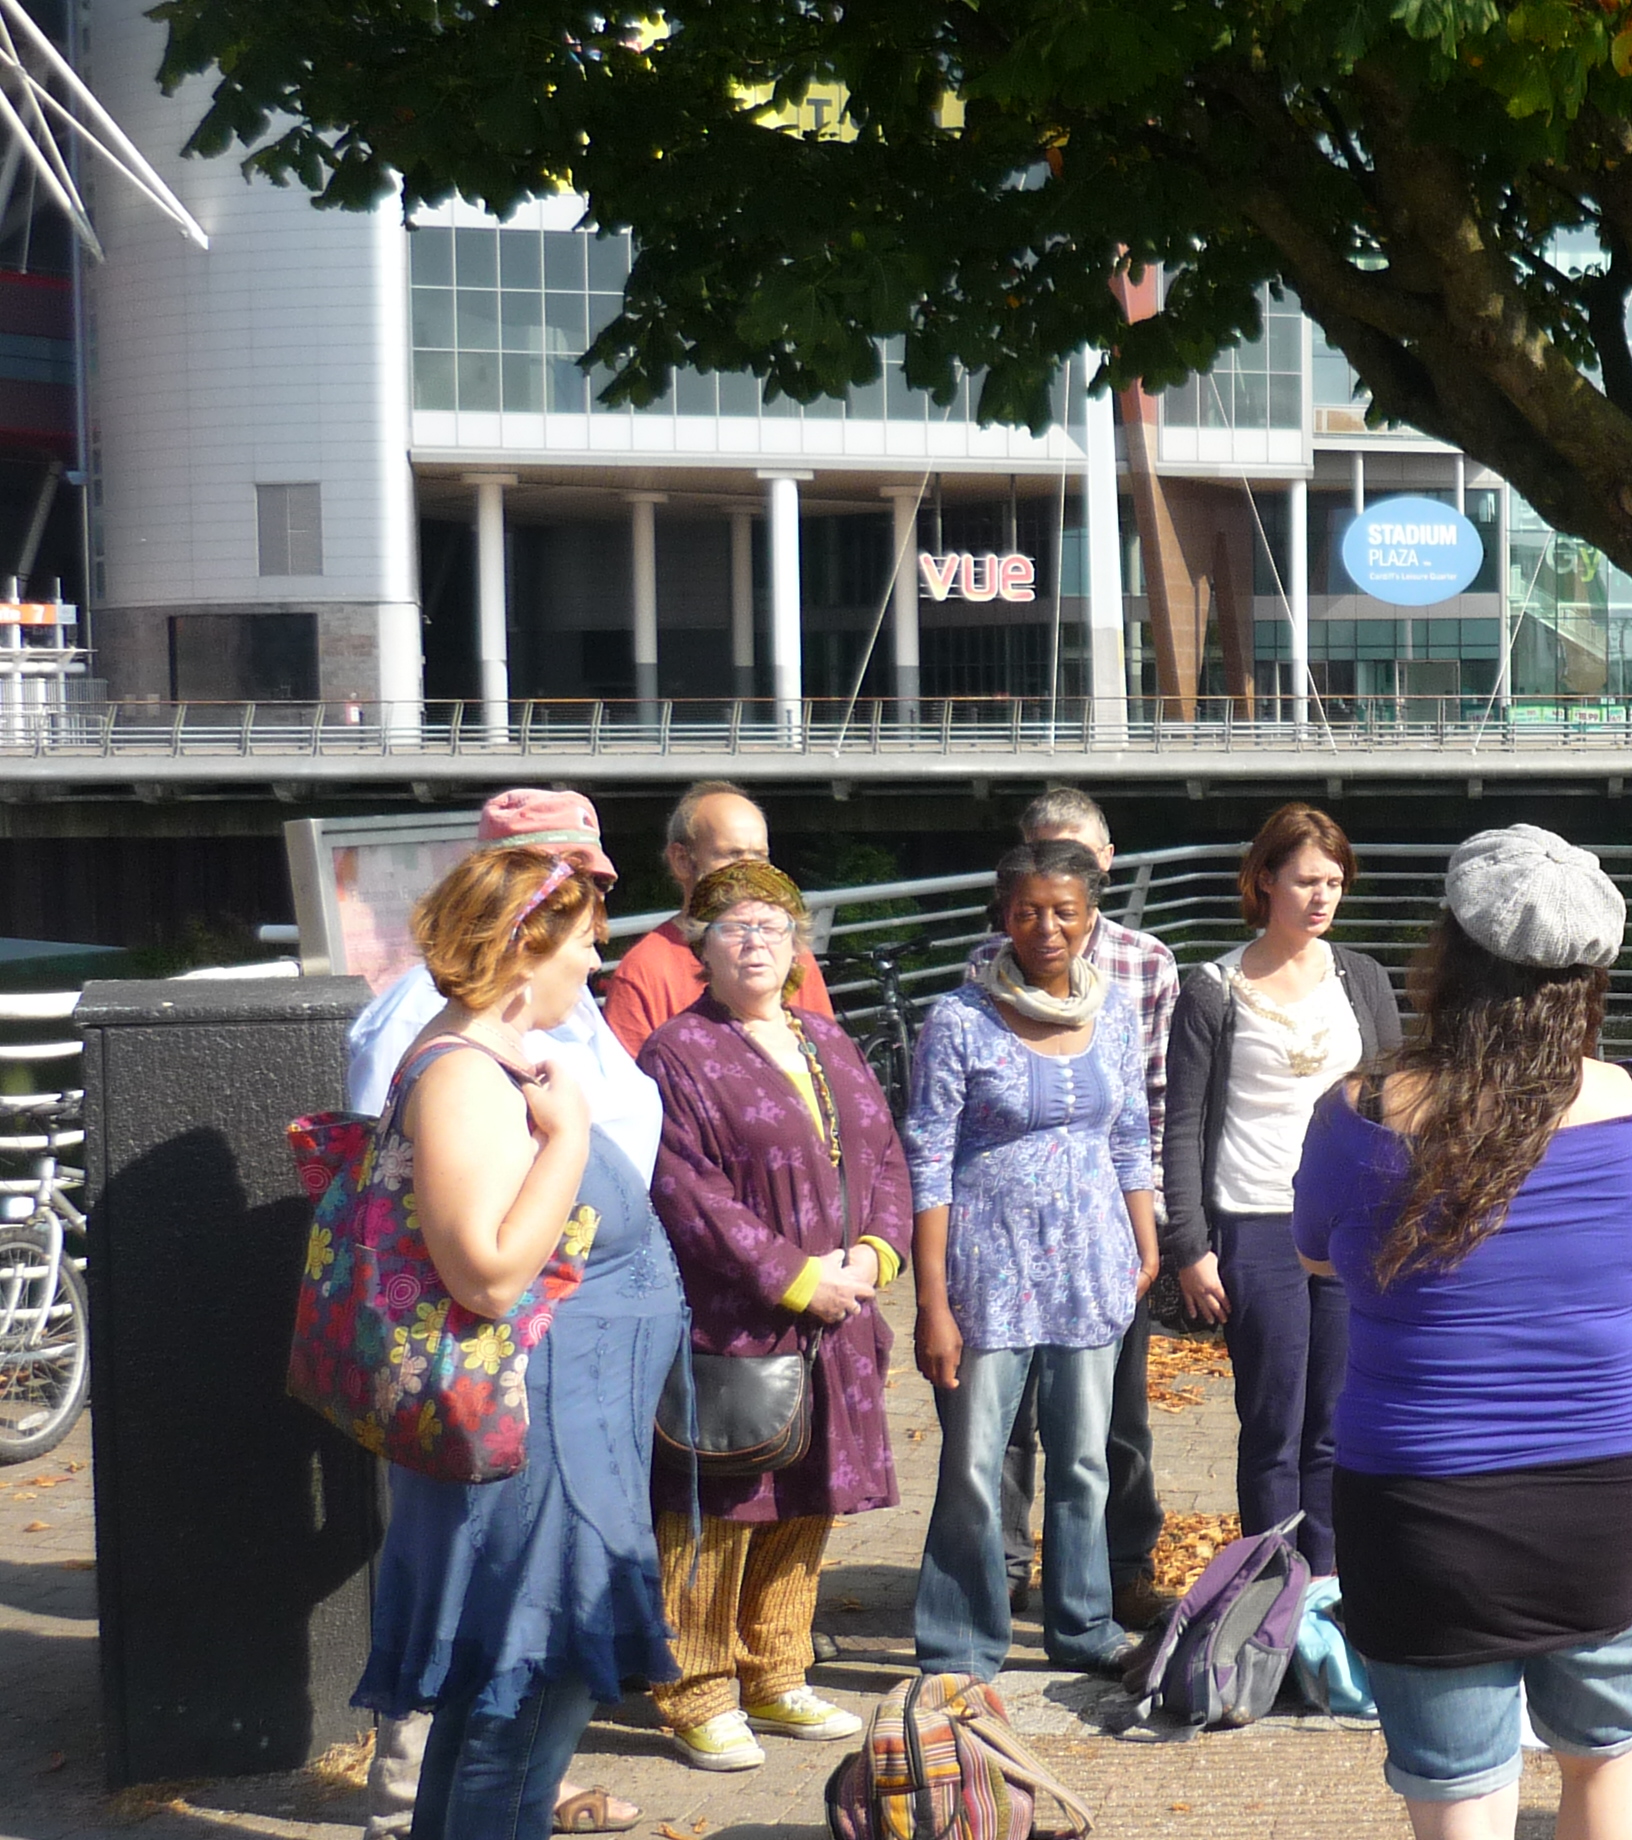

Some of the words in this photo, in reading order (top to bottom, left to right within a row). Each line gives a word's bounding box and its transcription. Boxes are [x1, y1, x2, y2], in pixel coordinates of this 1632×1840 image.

[1368, 524, 1457, 546] STADIUM
[1369, 548, 1419, 567] PLAZA
[1545, 538, 1601, 582] Gy
[1369, 572, 1399, 581] Cardiff's
[1401, 572, 1428, 581] Leisure
[1429, 572, 1457, 581] Quarter
[32, 604, 45, 623] 7
